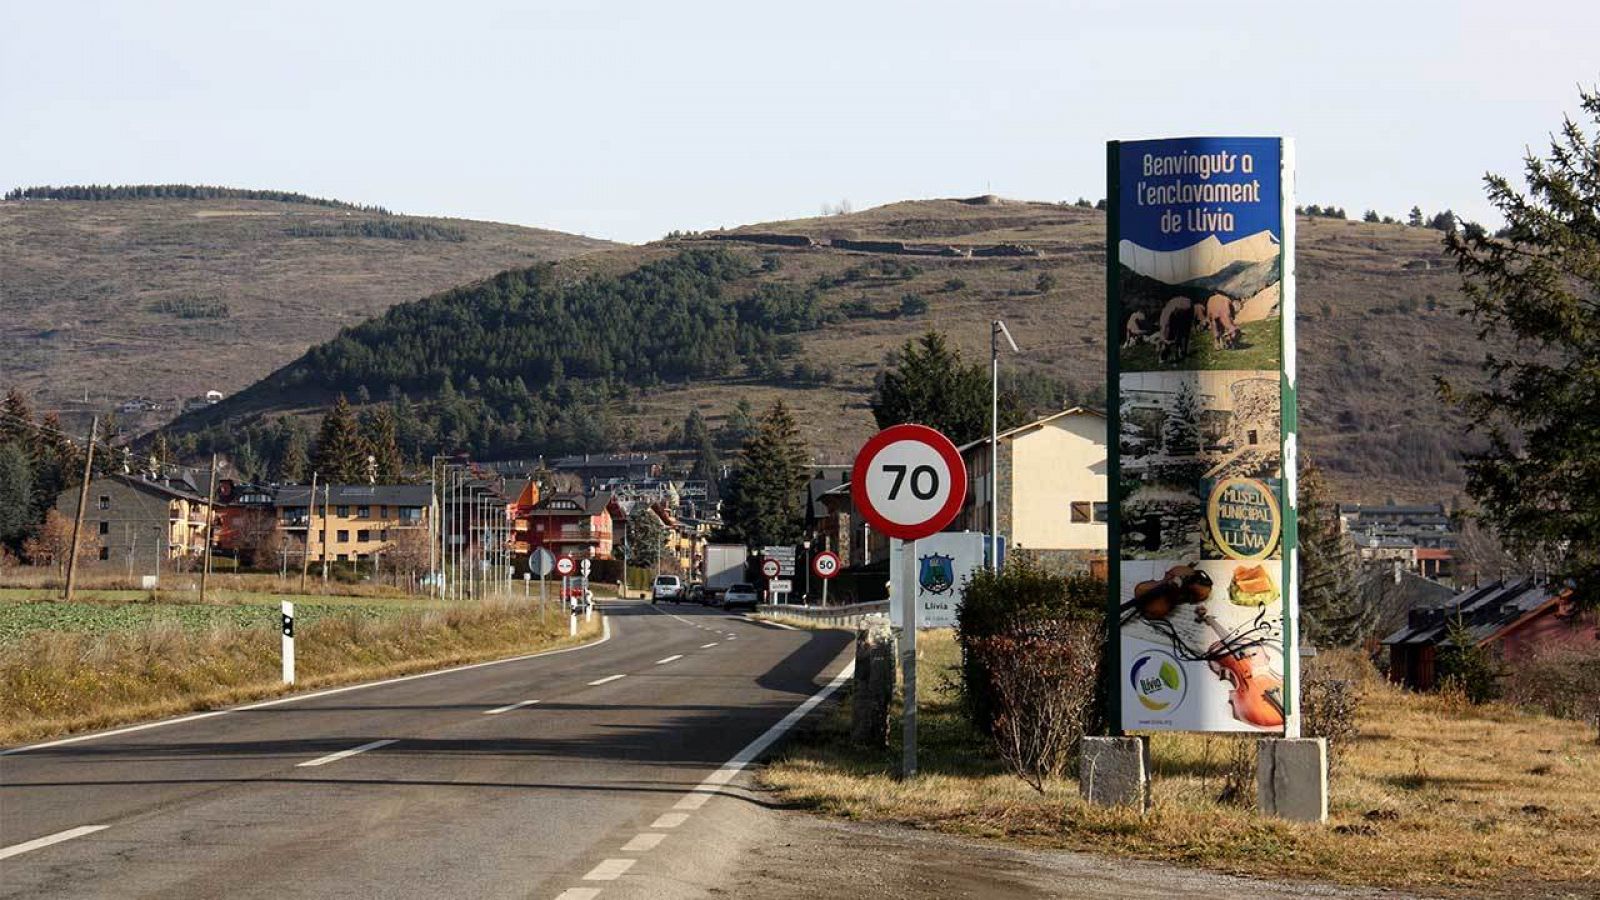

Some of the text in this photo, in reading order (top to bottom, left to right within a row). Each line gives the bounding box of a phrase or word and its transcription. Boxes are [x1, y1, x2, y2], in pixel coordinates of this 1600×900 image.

[1143, 150, 1253, 179] Benvinguts a
[1137, 180, 1260, 206] l'enclavament
[1160, 207, 1234, 234] de Llívia
[882, 464, 940, 501] 70
[819, 560, 834, 570] 50
